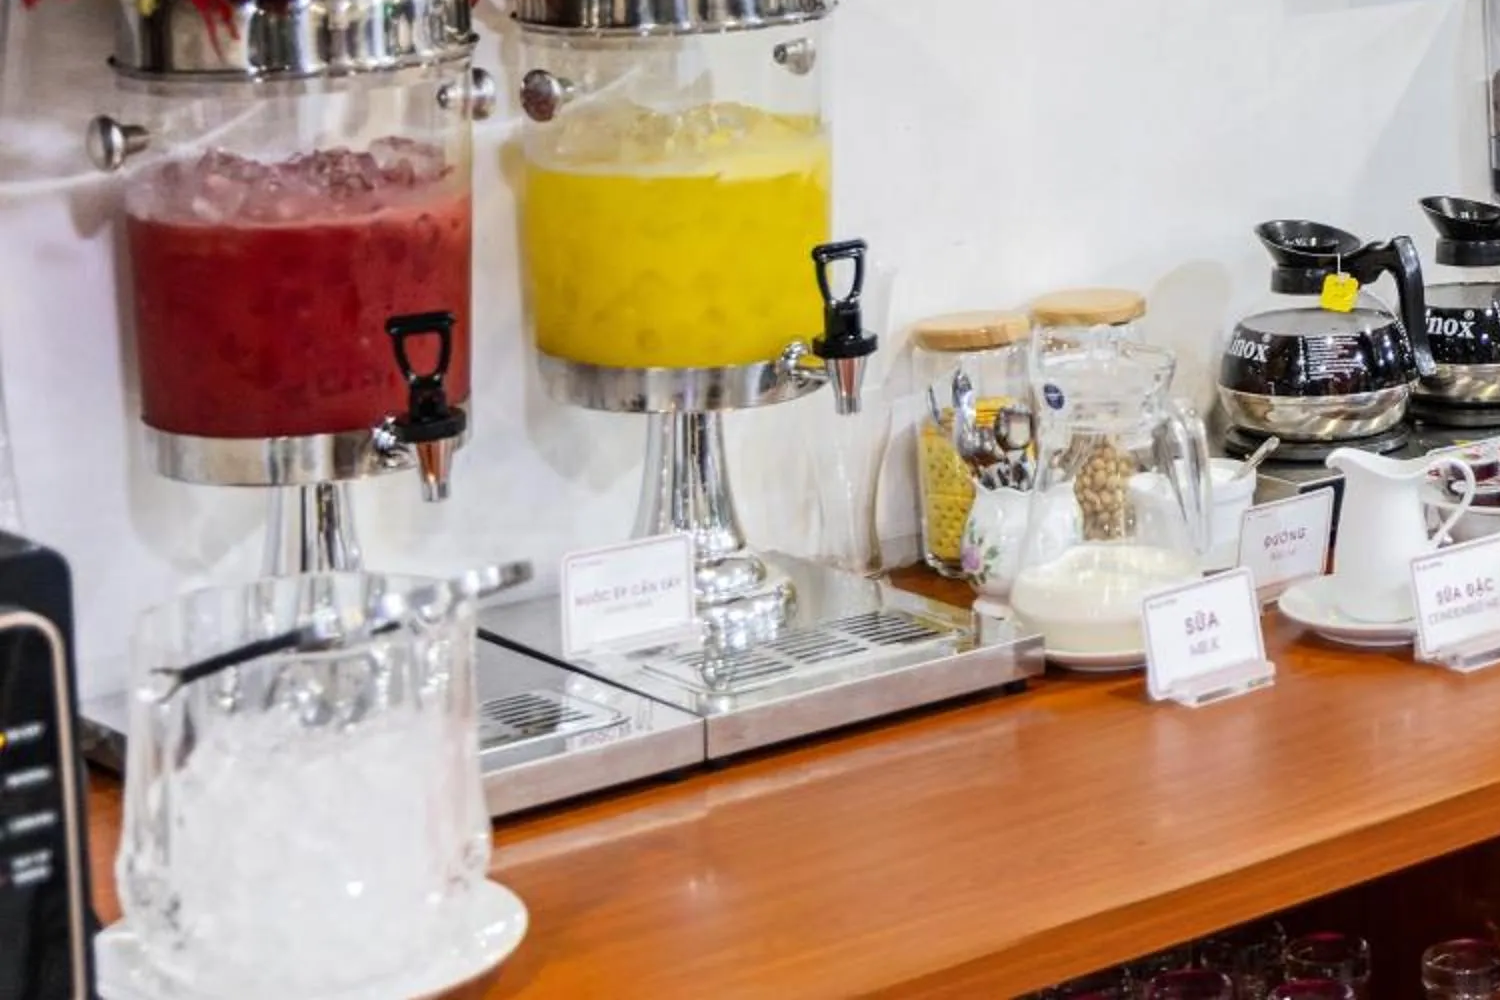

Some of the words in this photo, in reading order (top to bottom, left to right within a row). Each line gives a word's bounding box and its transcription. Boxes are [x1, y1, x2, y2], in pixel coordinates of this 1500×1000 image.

[1435, 583, 1462, 606] SỮA
[1465, 576, 1495, 598] ĐẶC
[1184, 610, 1220, 635] SỮA
